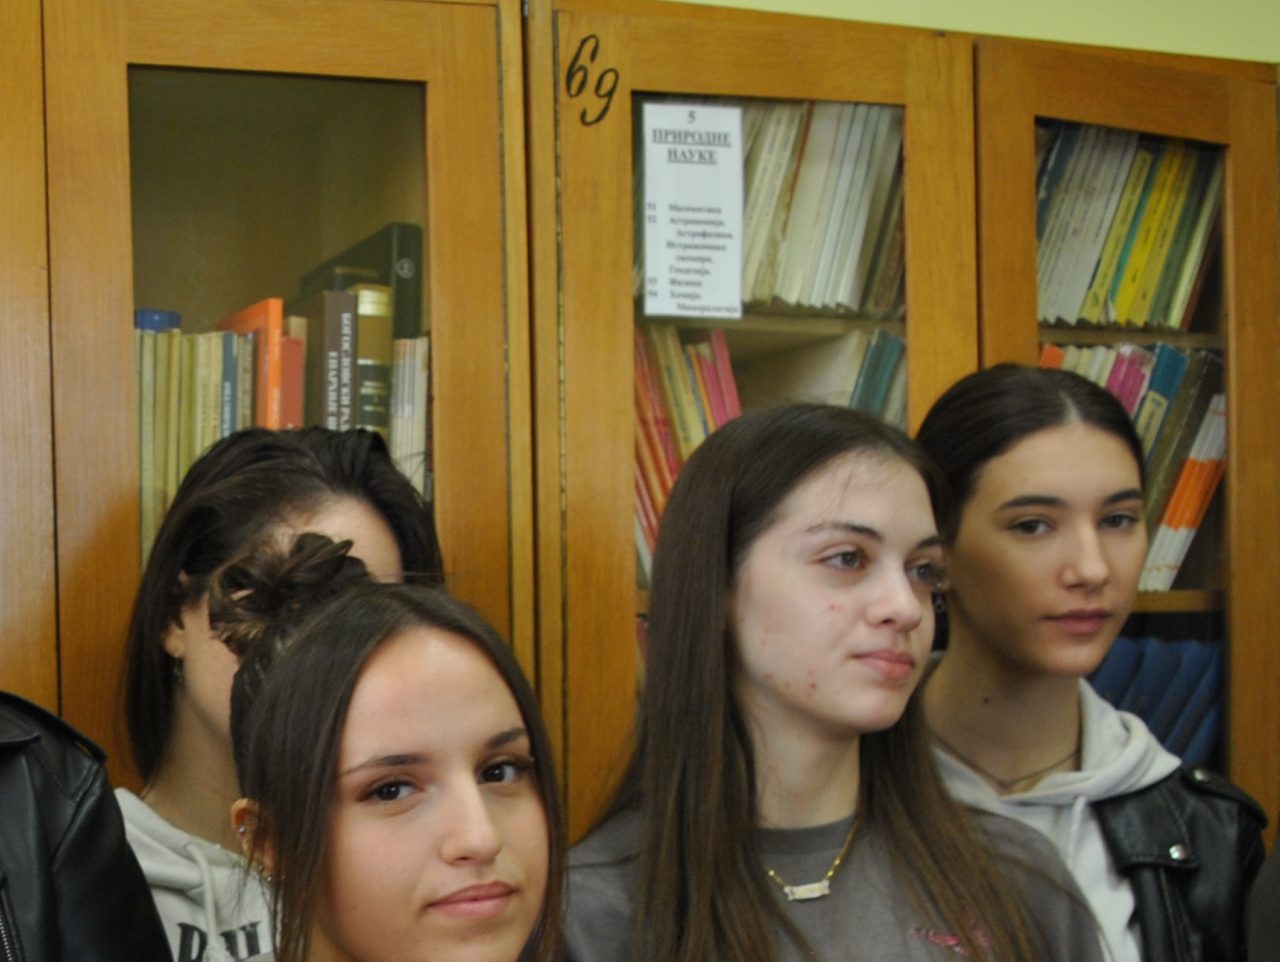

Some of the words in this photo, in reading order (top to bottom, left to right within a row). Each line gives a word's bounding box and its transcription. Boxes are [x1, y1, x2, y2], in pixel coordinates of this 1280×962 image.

[565, 33, 620, 127] 69
[688, 110, 696, 124] 5
[652, 129, 731, 147] ПРИРОДНЕ
[668, 148, 717, 165] НАУКЕ
[668, 204, 722, 213] Математика
